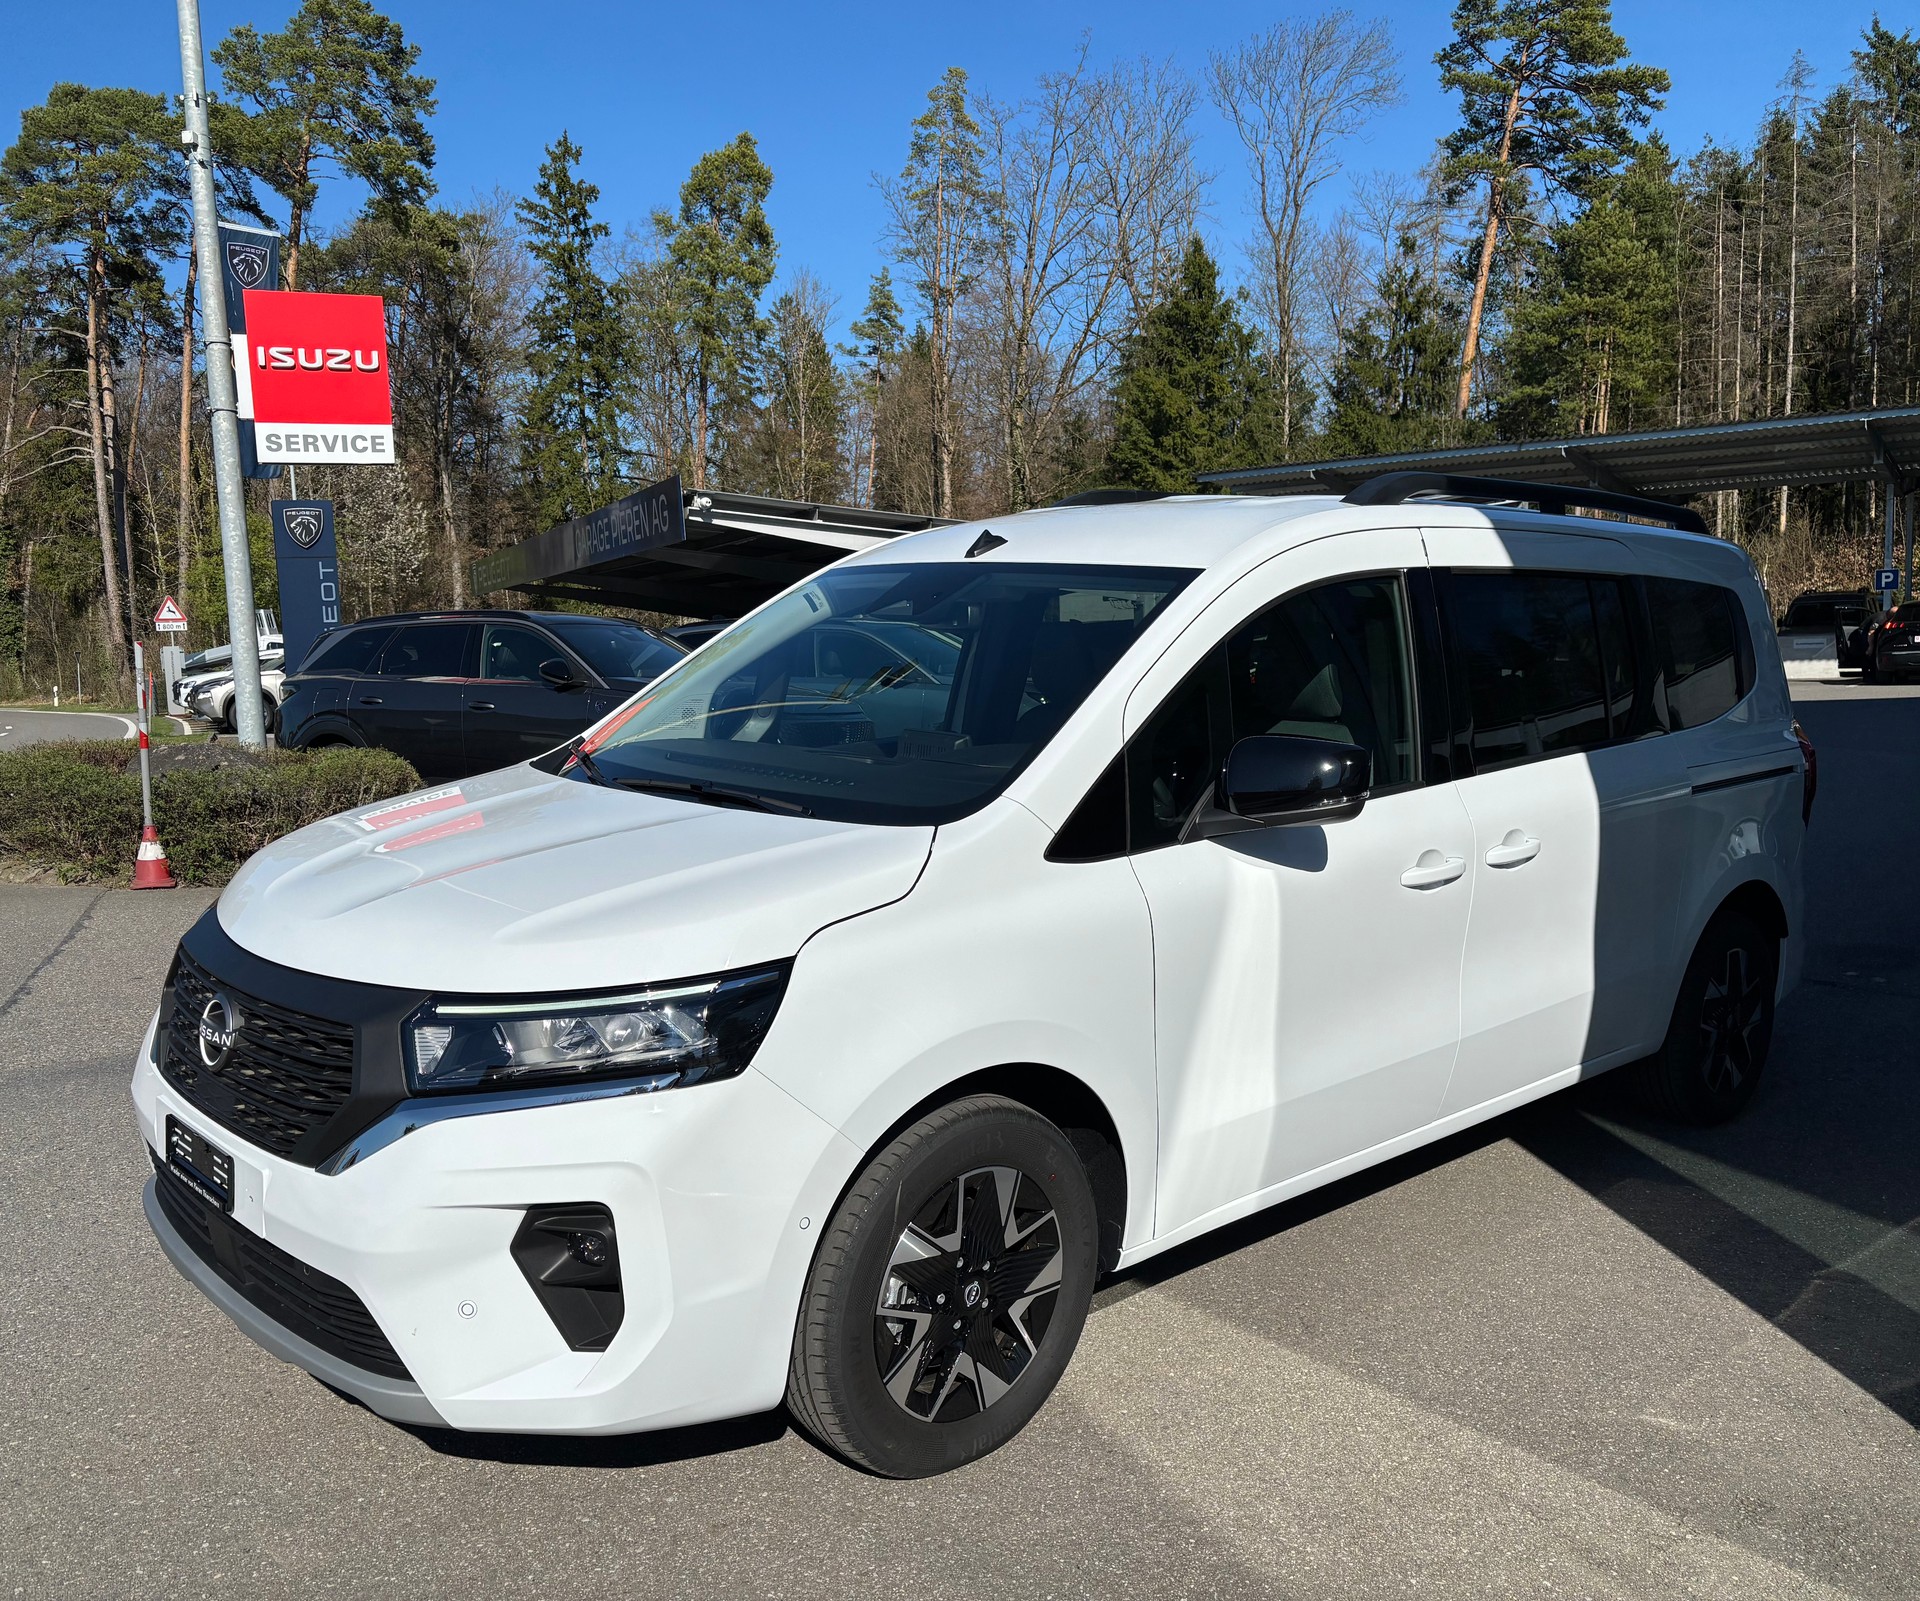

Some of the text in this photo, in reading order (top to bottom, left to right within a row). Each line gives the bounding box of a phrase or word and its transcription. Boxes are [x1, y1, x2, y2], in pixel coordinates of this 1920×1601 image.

[230, 245, 266, 255] PEUGEOT
[257, 346, 380, 371] ISUZU
[265, 433, 386, 453] SERVICE
[575, 494, 669, 558] GARAGE PIEREN AG
[1881, 572, 1894, 588] P
[319, 561, 338, 631] EOT
